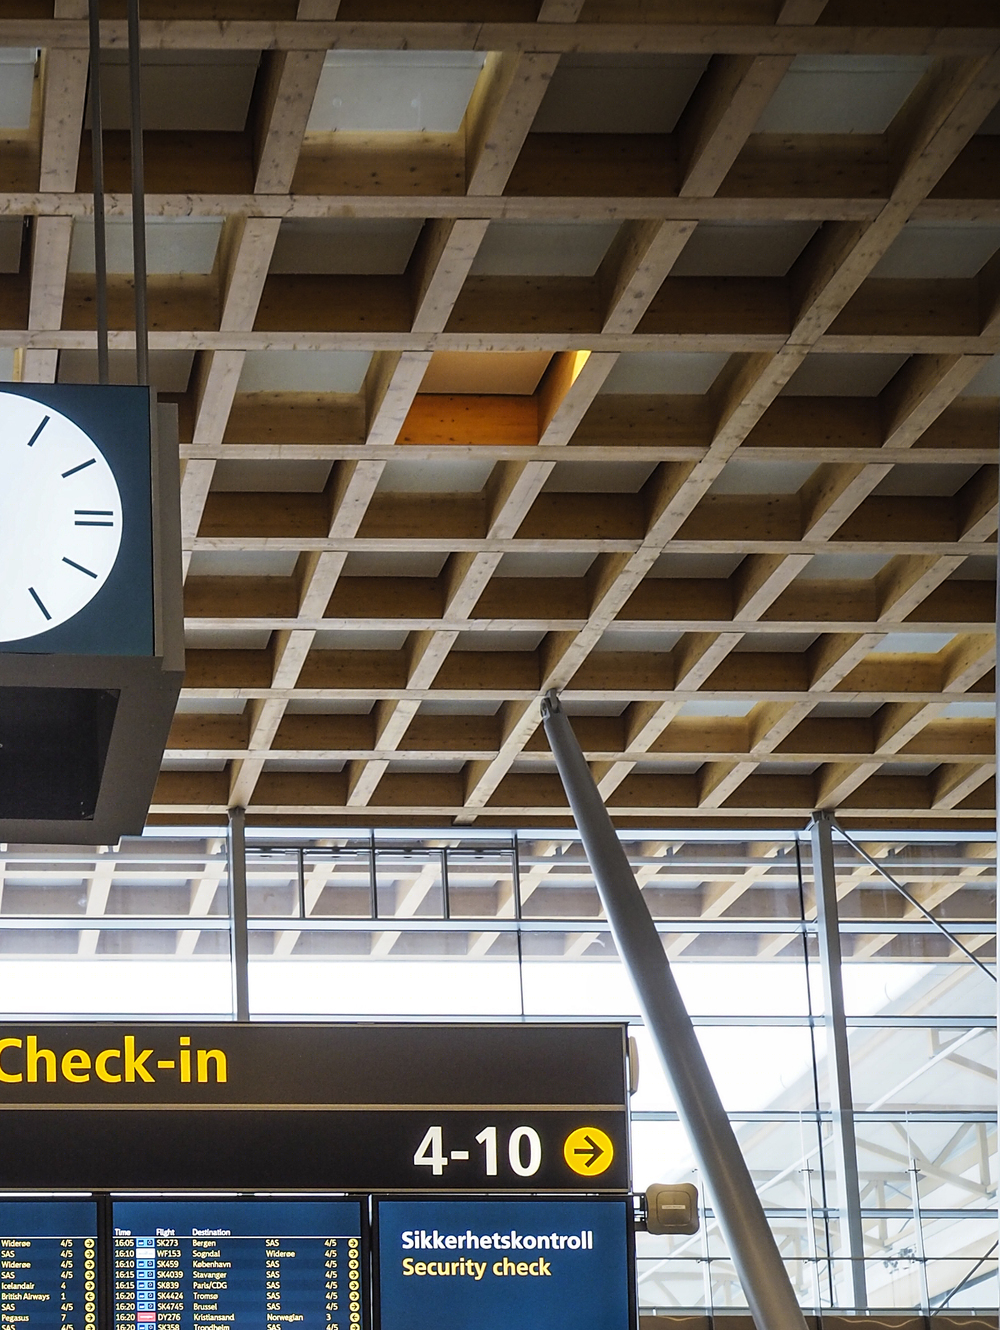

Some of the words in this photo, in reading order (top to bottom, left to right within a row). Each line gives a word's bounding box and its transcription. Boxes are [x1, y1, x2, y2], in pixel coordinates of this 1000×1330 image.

[413, 1126, 542, 1177] 4-10
[115, 1228, 130, 1237] Time
[157, 1228, 175, 1238] Flight
[192, 1228, 230, 1237] Destination
[401, 1229, 593, 1250] Sikkerhetskontroll
[115, 1249, 135, 1258] 16:10
[192, 1249, 221, 1259] Sogndal
[266, 1249, 296, 1258] Widerøe
[324, 1249, 338, 1258] 4/5
[402, 1257, 487, 1281] Security
[492, 1257, 552, 1276] check
